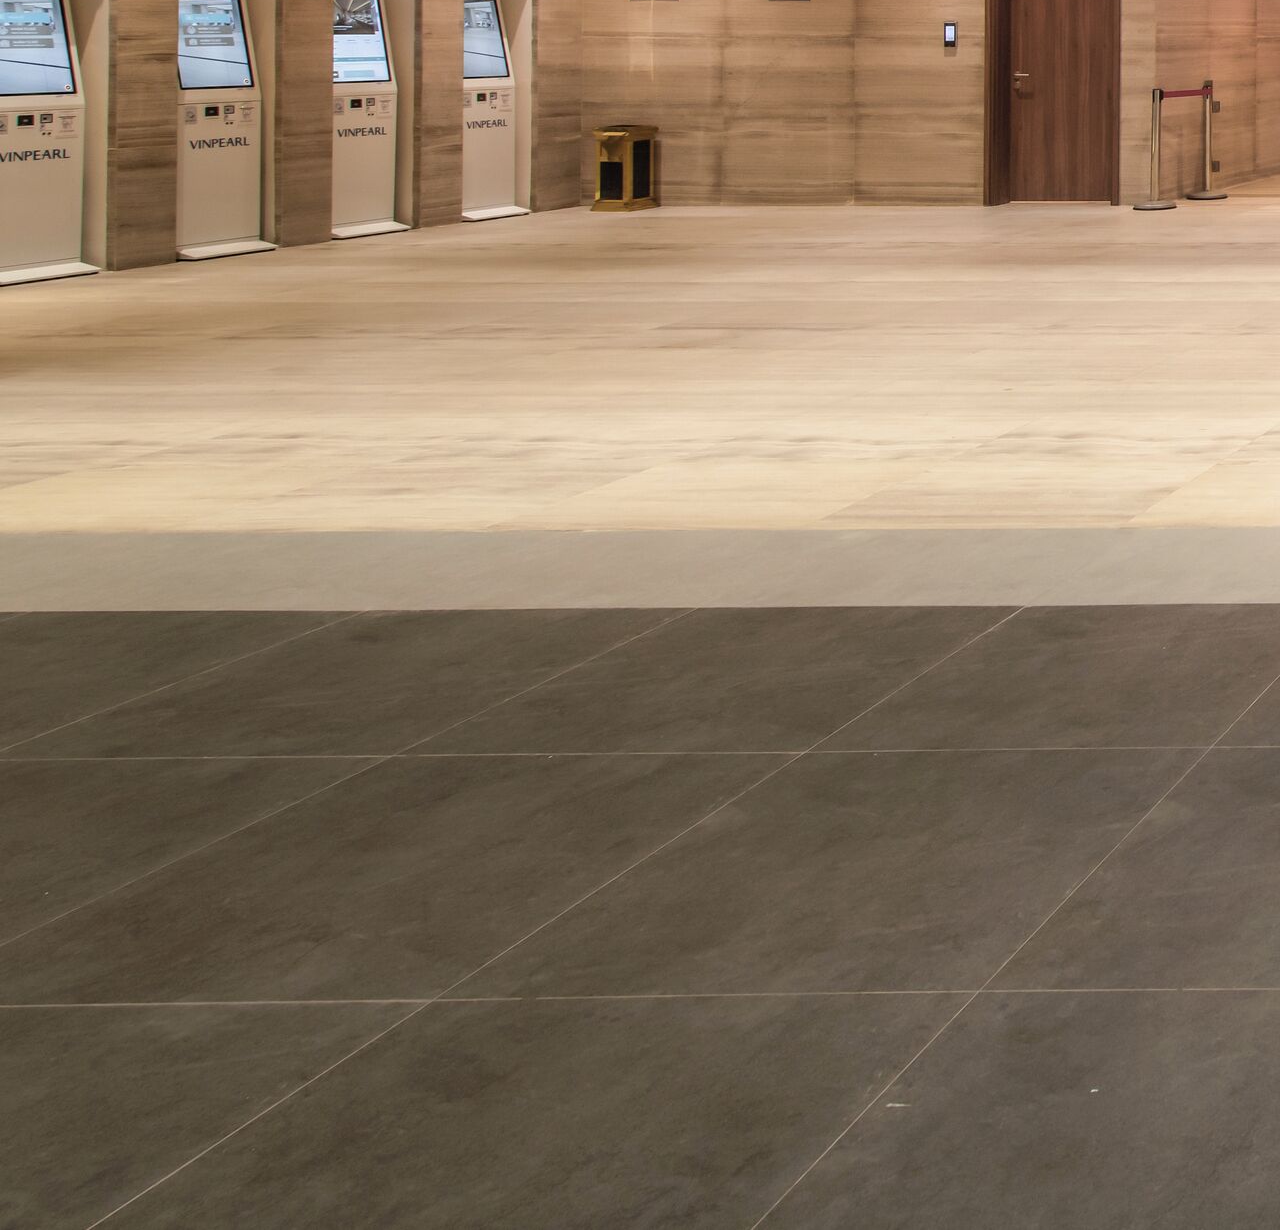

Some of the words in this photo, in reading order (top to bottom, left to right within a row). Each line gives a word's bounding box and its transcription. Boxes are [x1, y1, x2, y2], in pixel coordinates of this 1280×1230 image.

[466, 119, 507, 129] VINPEARL
[337, 127, 387, 137] VINPEARL
[190, 137, 250, 150] VINPEARL
[0, 149, 71, 162] VINPEARL
